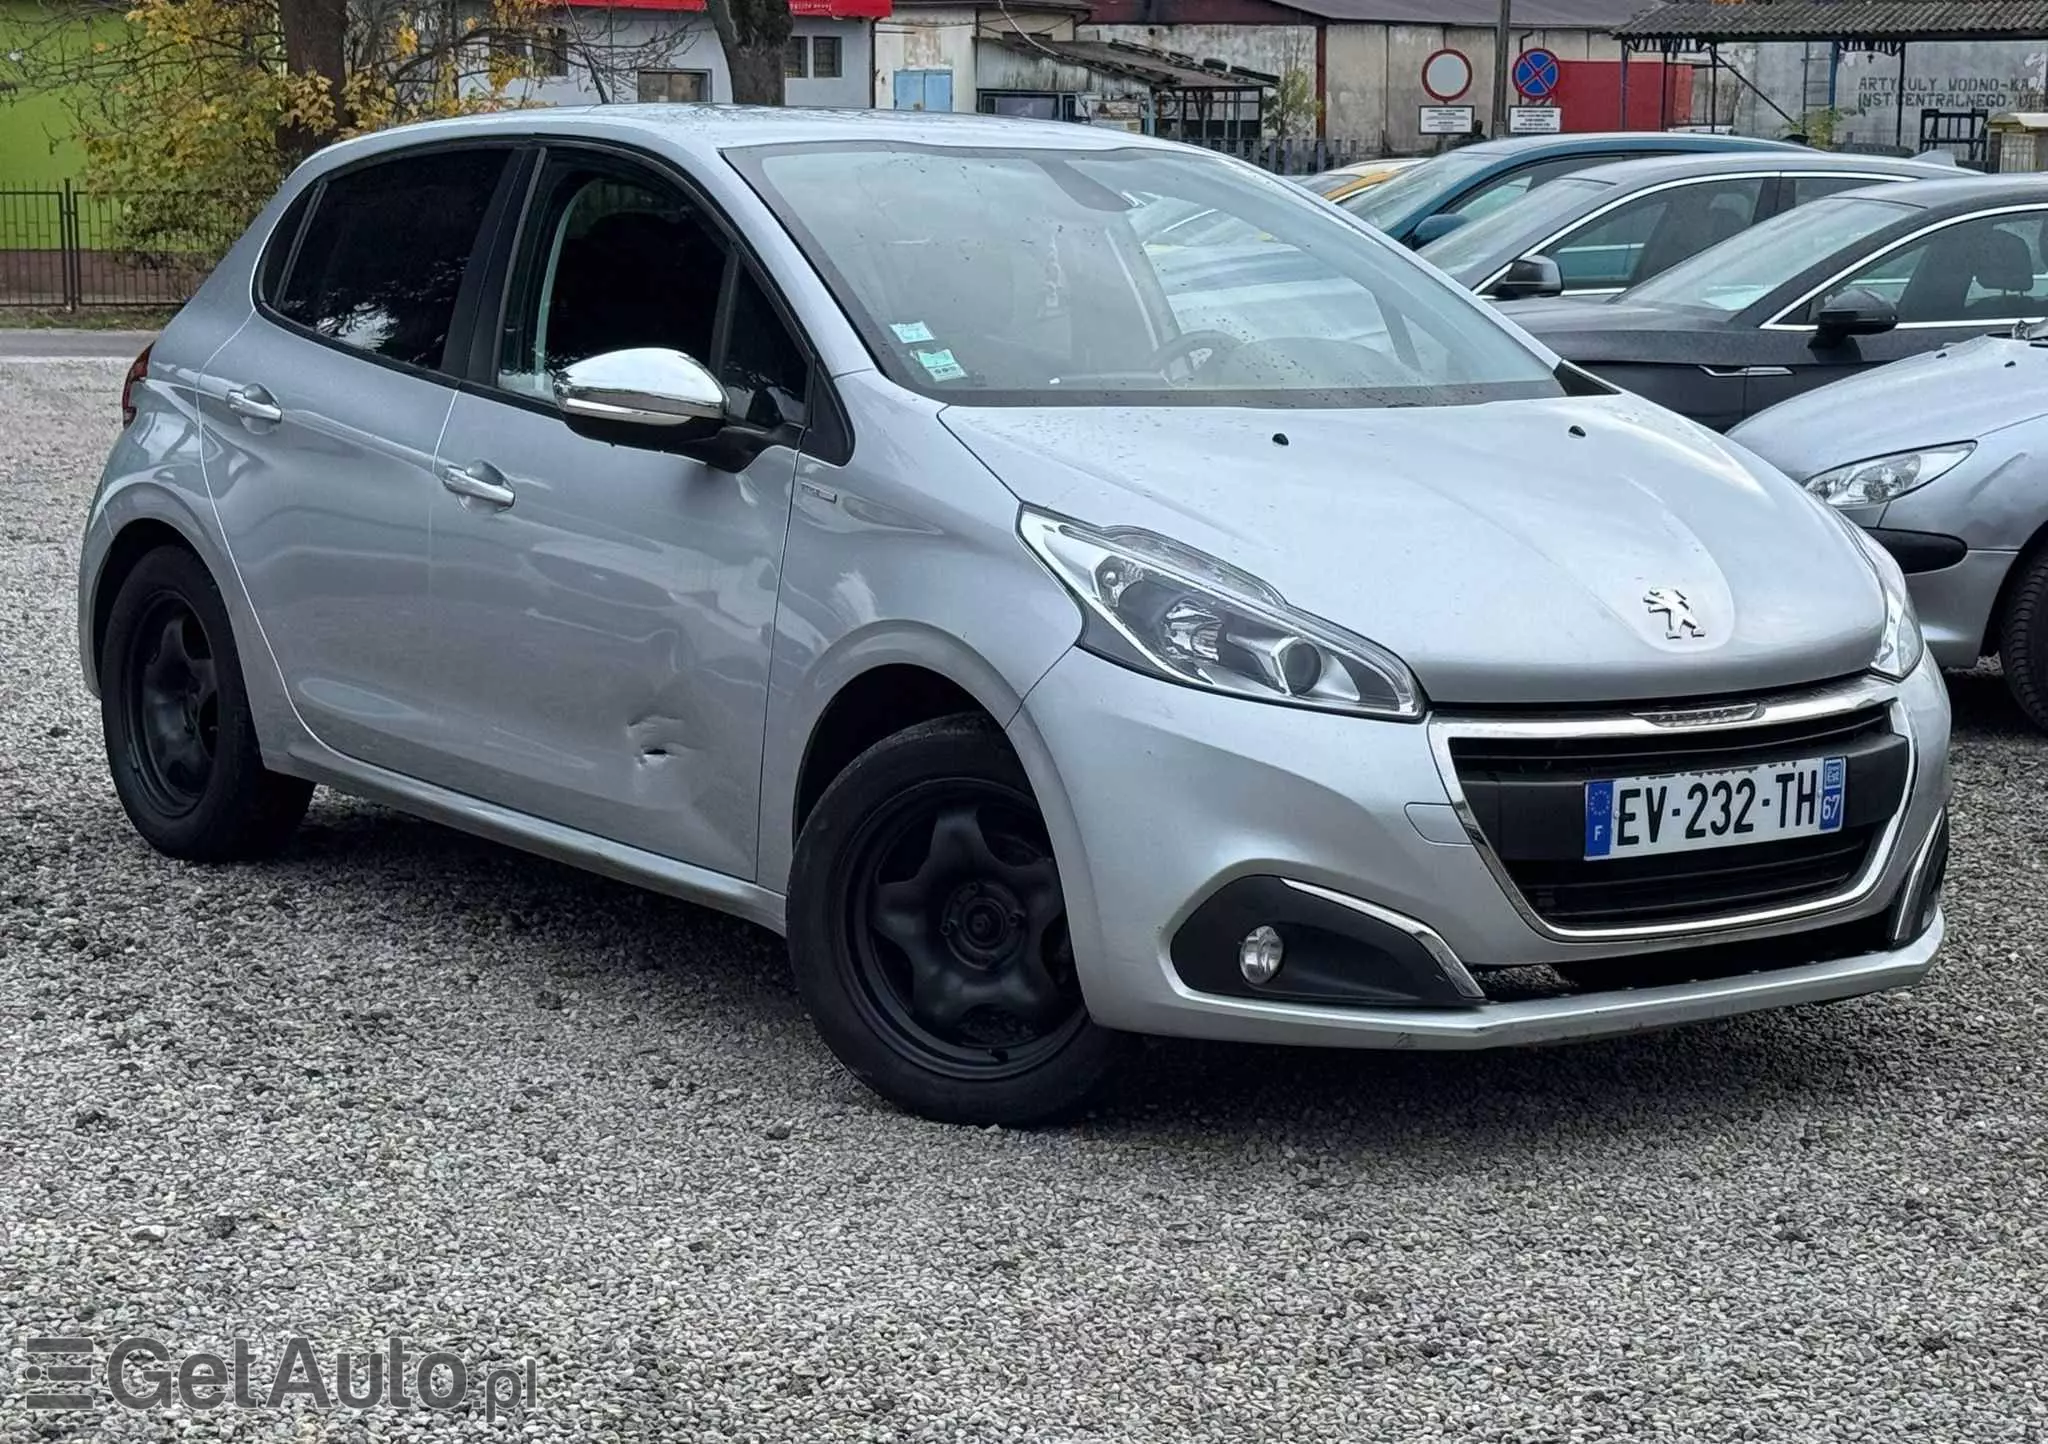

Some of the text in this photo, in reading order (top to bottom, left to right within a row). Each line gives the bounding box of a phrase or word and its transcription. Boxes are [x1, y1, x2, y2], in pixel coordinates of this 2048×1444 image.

[1594, 769, 1818, 847] F EV-232-TH
[1822, 794, 1841, 820] 67
